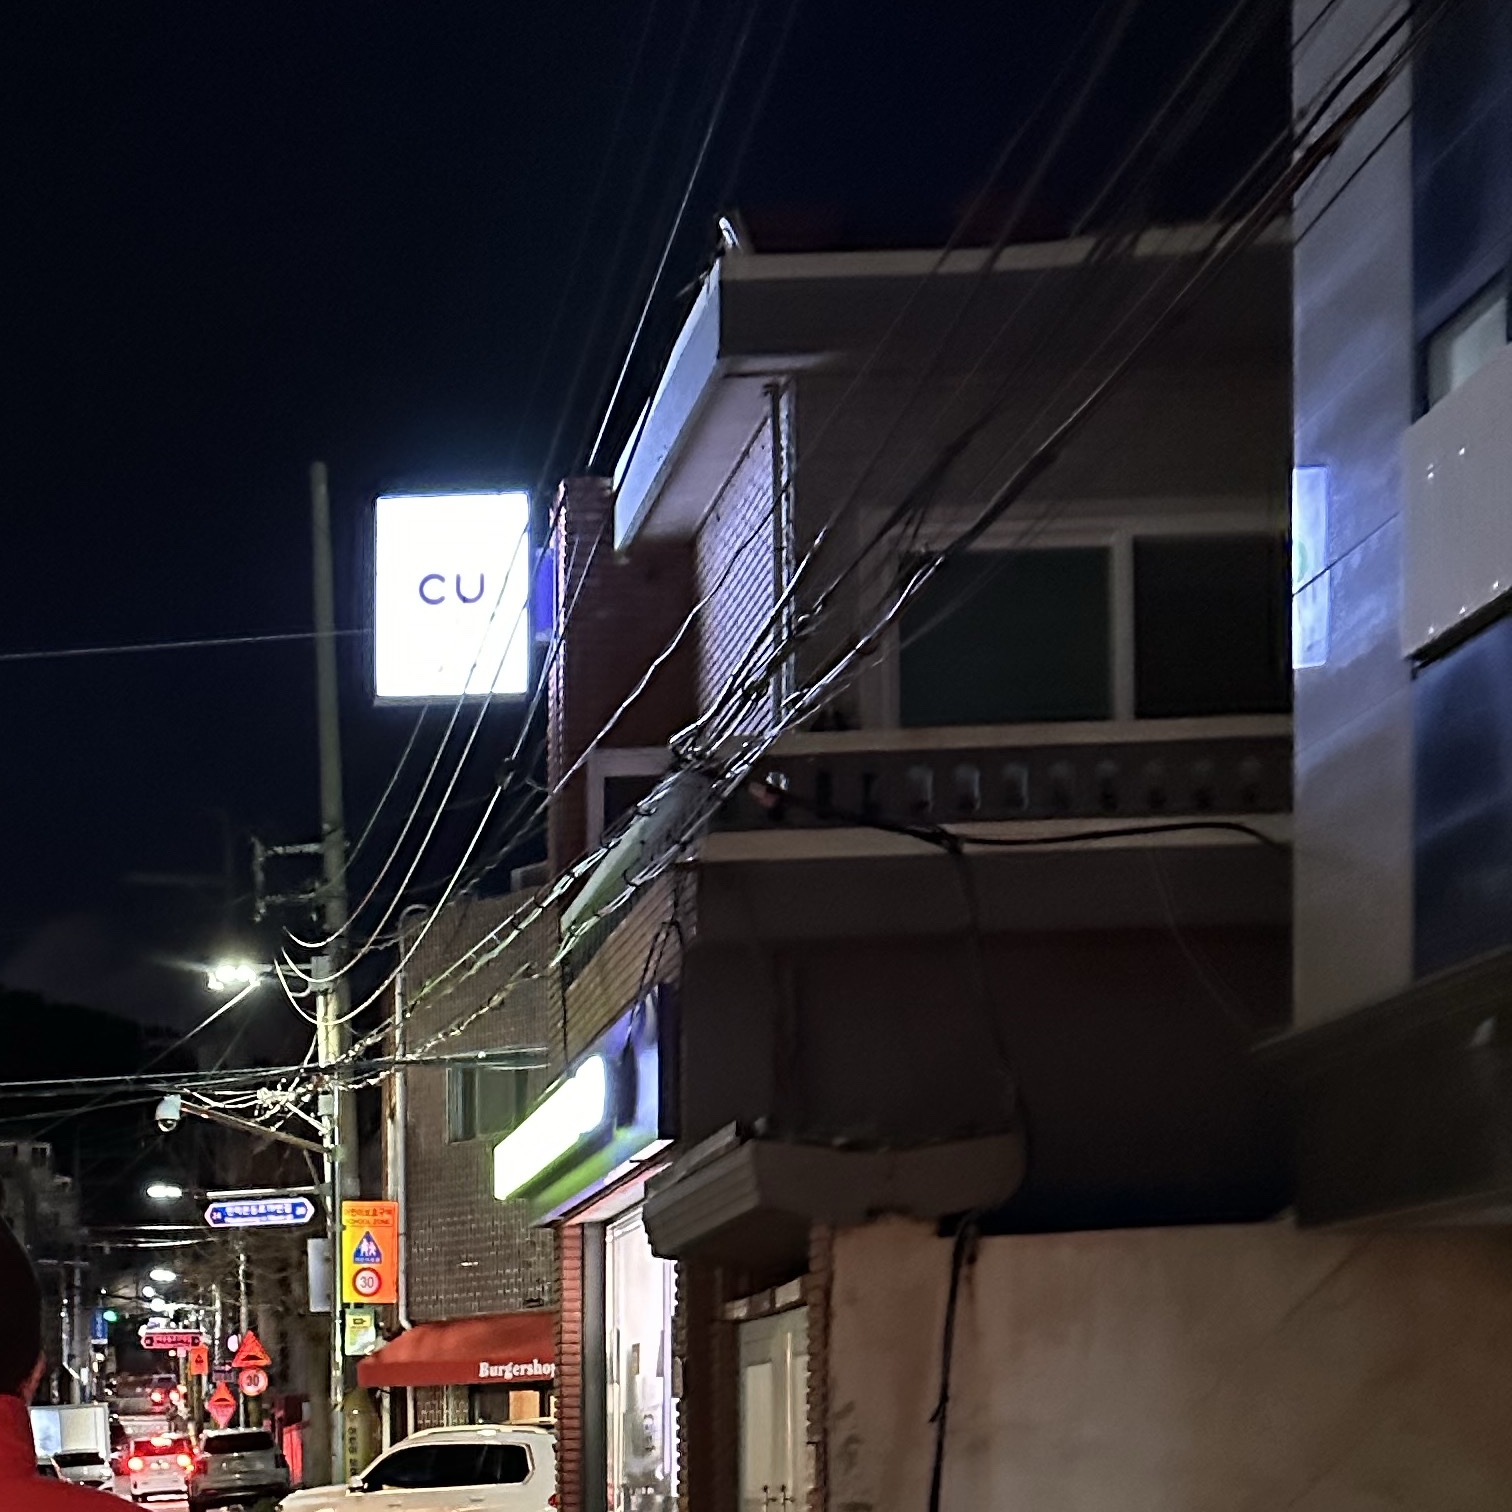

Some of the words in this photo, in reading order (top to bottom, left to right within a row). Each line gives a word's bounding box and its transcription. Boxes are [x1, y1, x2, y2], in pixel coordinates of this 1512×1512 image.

[419, 573, 484, 605] CU
[360, 1276, 374, 1289] 30
[246, 1375, 260, 1387] 30
